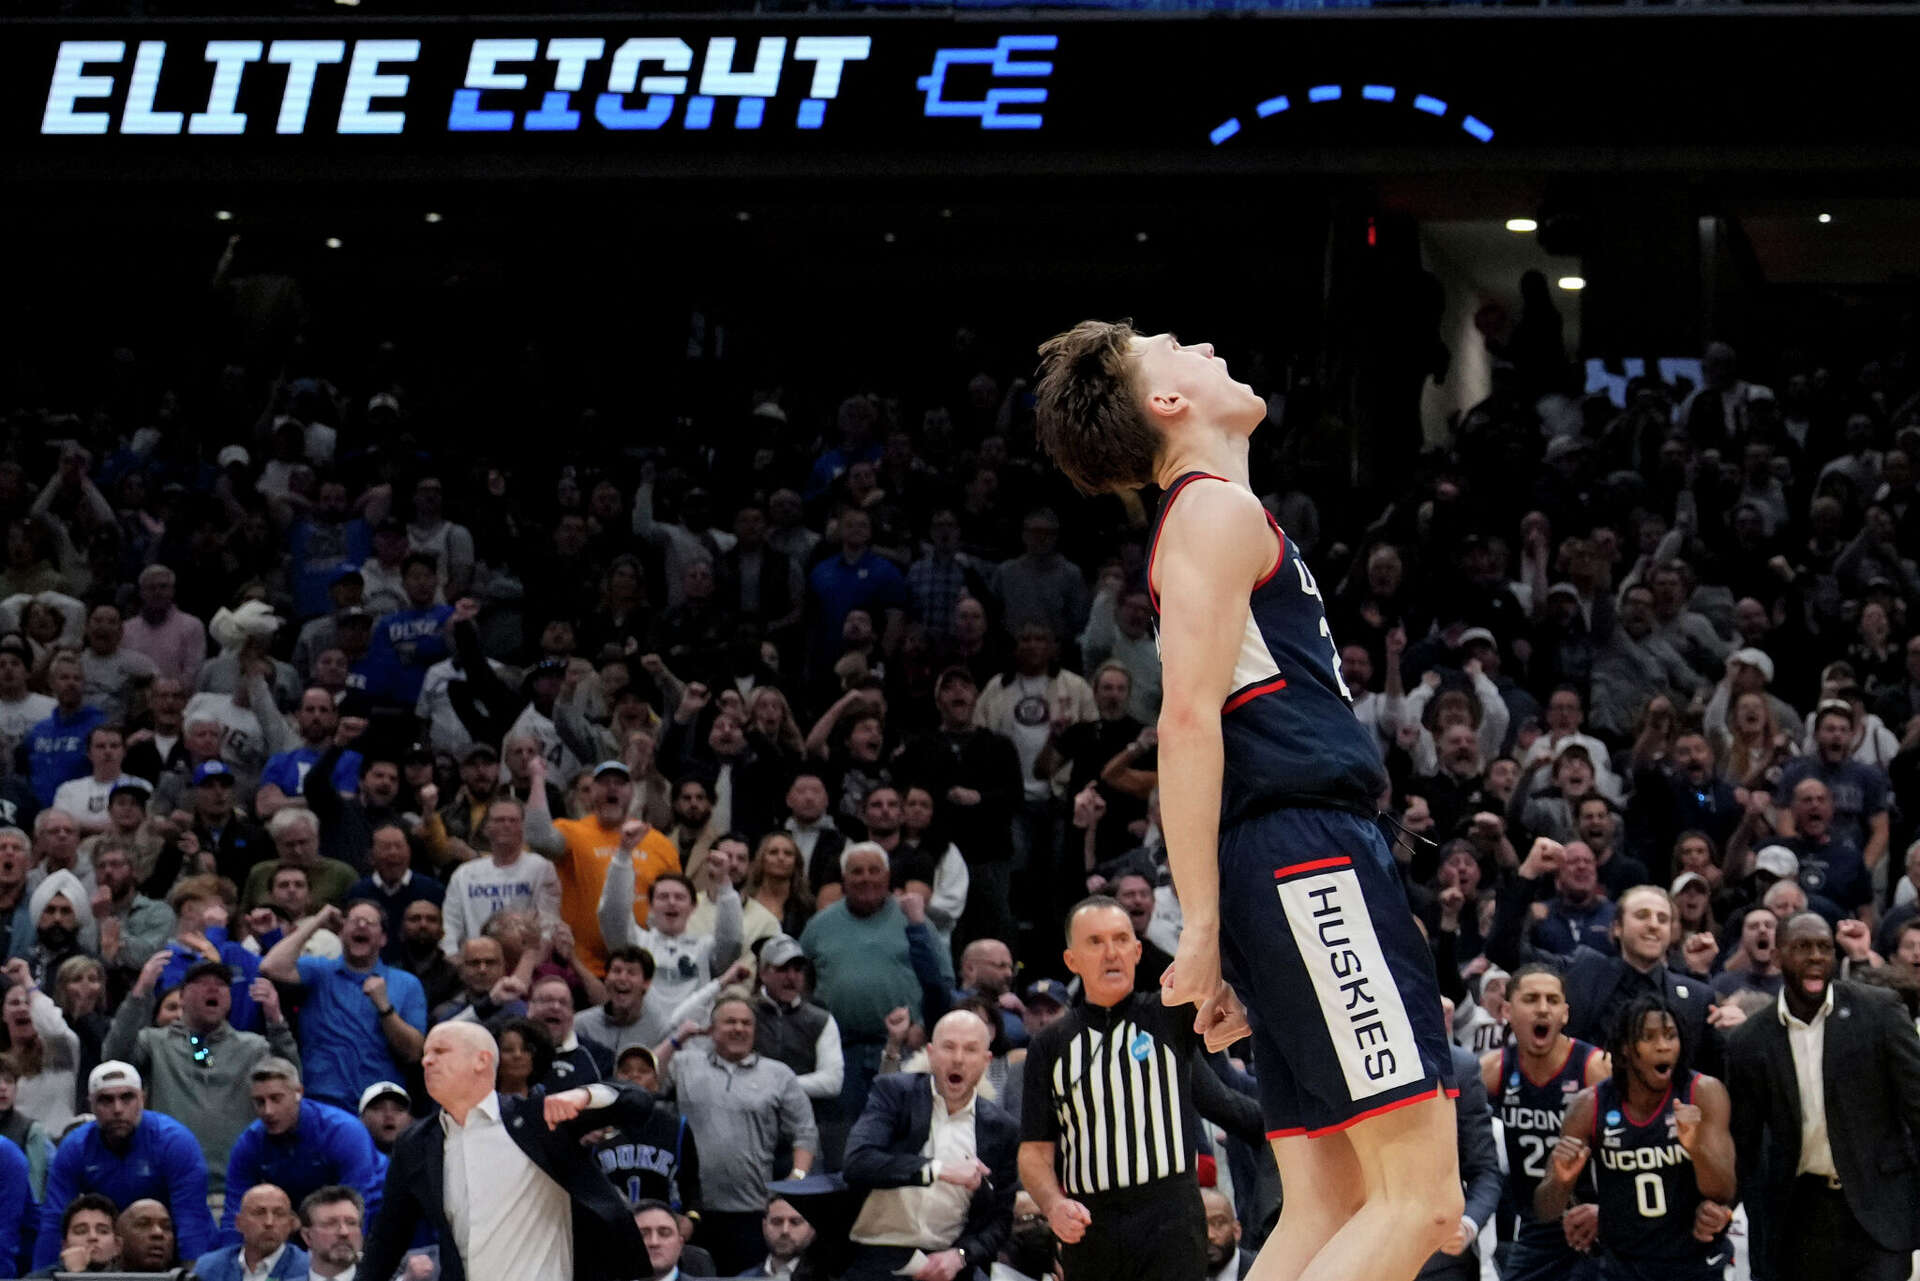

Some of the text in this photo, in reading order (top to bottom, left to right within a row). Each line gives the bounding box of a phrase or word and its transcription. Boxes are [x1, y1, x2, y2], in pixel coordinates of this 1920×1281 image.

[41, 37, 870, 134] ELITE EIGHT
[1308, 886, 1397, 1081] HUSKIES
[1501, 1106, 1565, 1131] UCON
[597, 1143, 675, 1177] DUKE
[1634, 1172, 1668, 1218] 0
